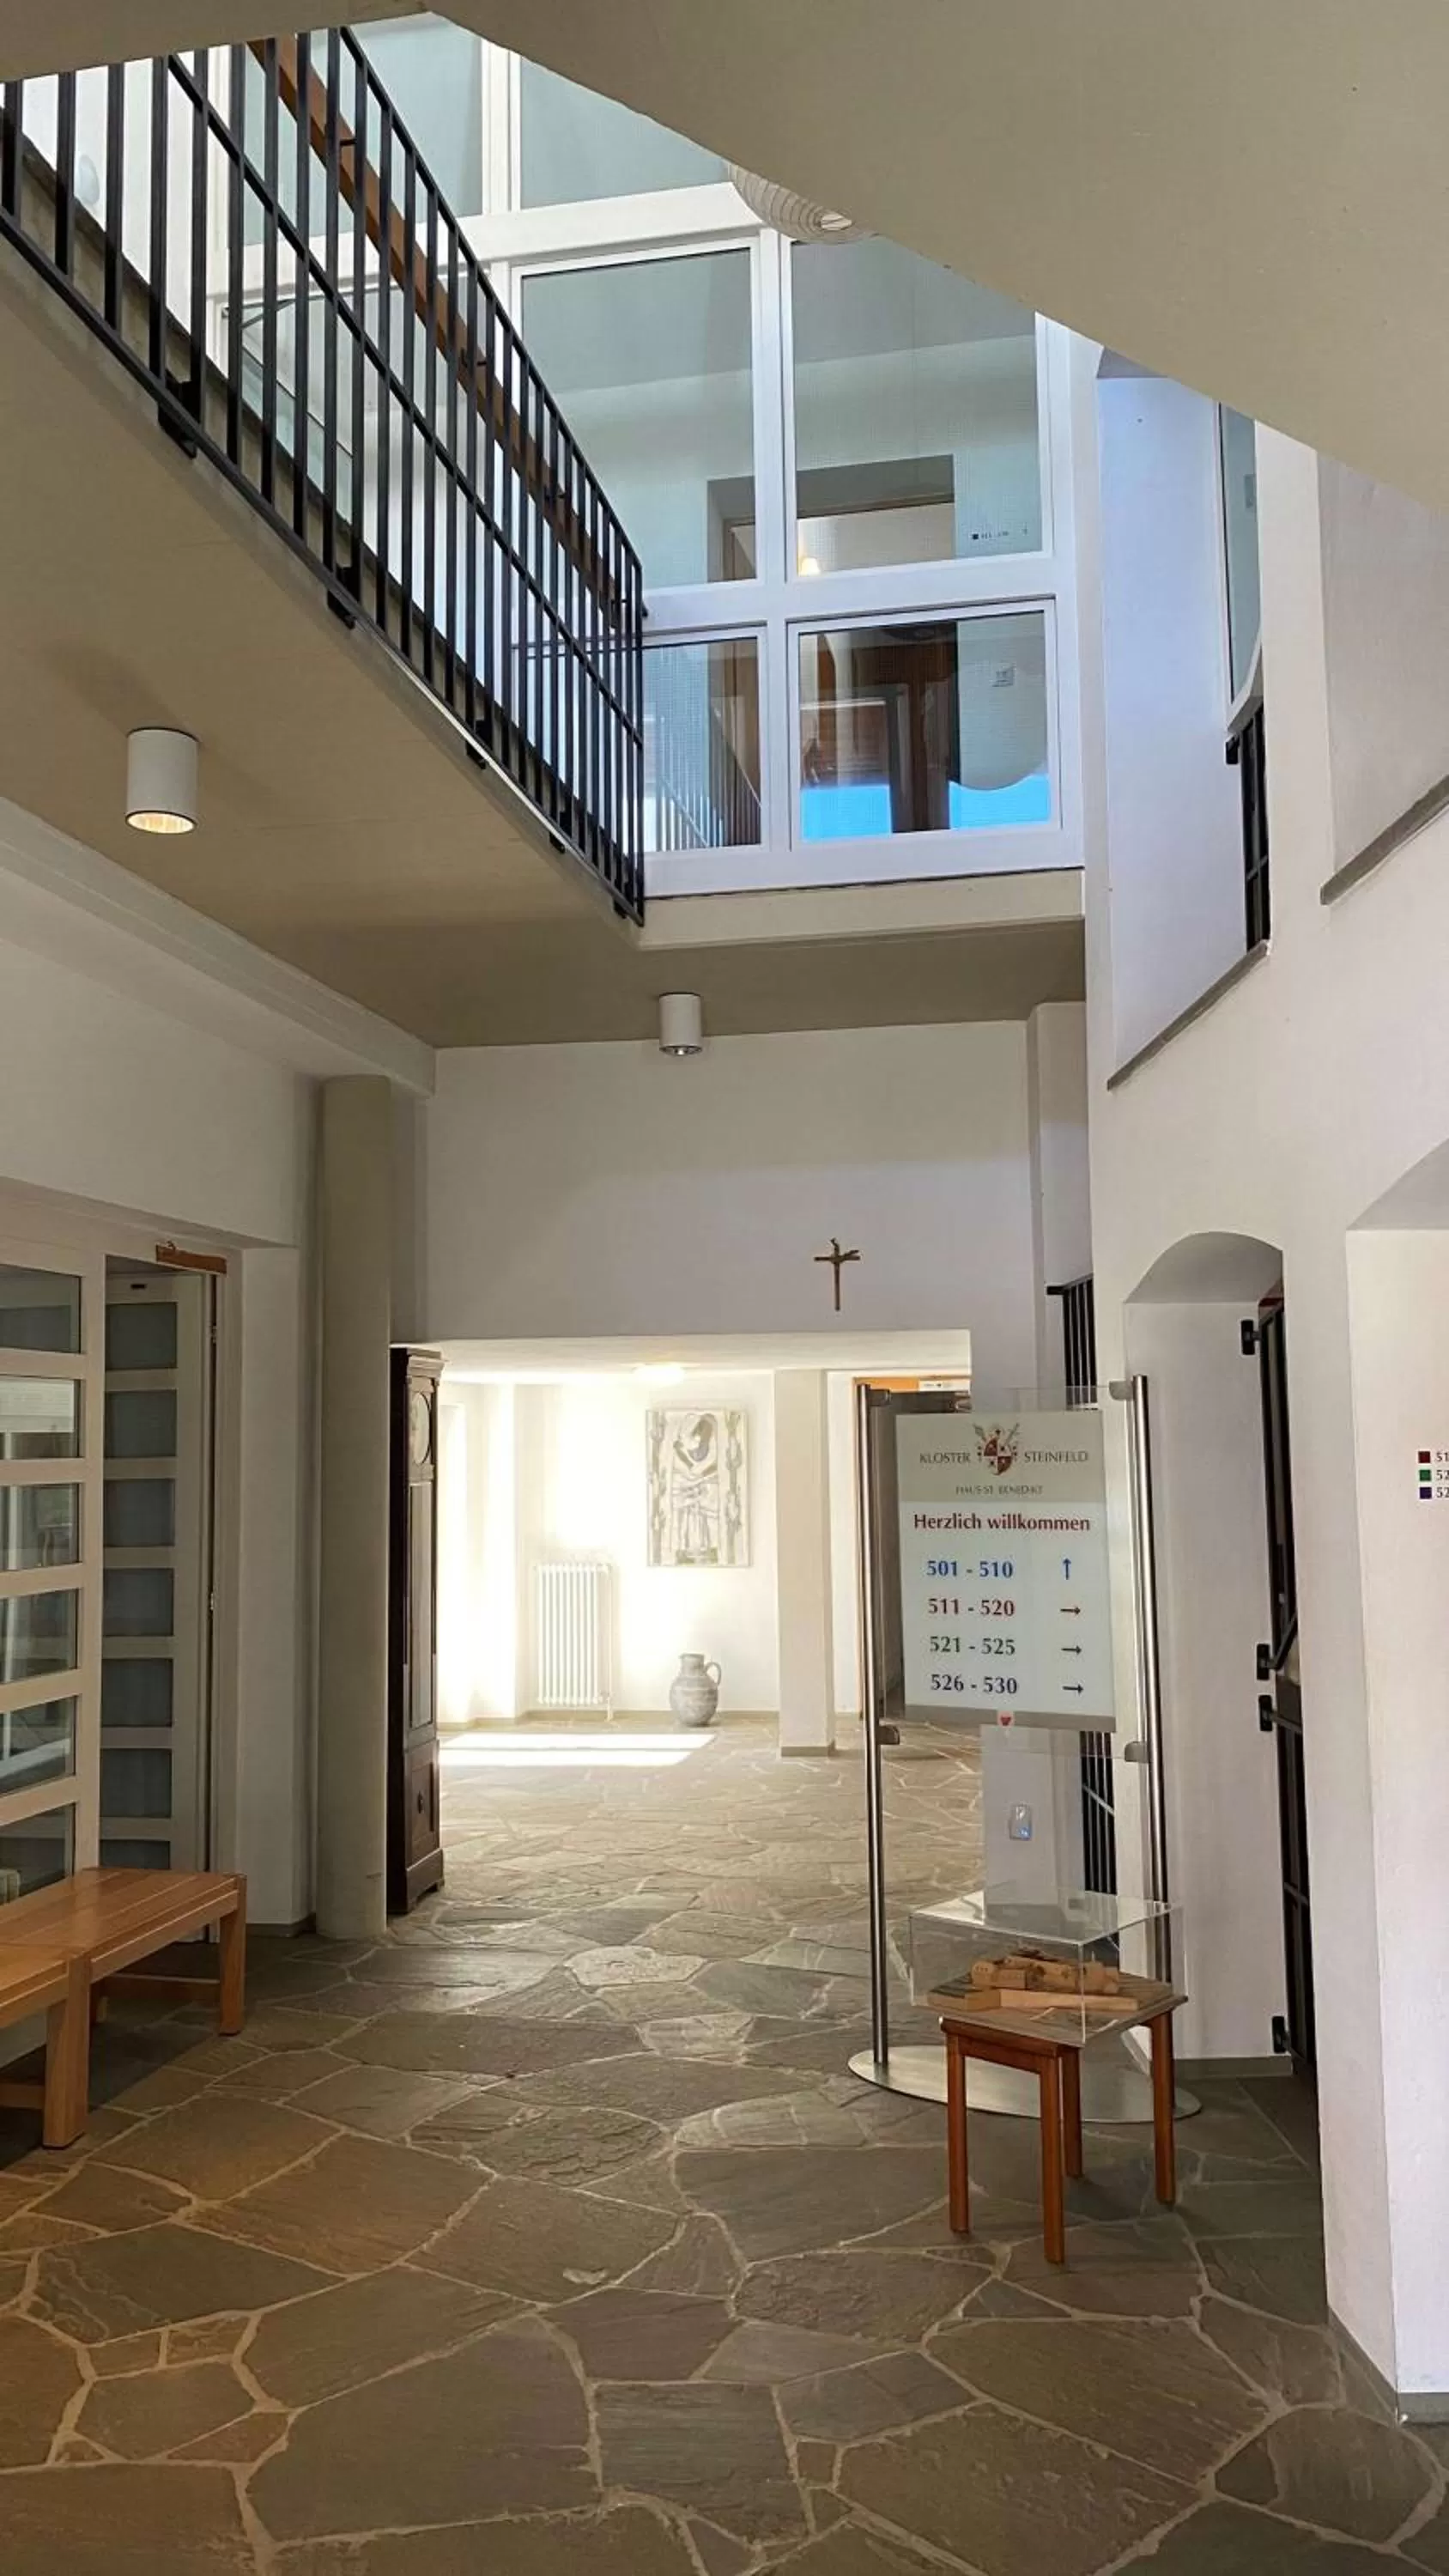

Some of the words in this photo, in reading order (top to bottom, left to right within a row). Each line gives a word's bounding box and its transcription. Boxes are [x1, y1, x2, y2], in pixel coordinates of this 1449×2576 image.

[919, 1452, 971, 1464] KLOSTER
[1024, 1450, 1088, 1463] STEINFELD
[914, 1513, 981, 1529] Herzlich
[986, 1514, 1090, 1532] willkommen
[926, 1560, 959, 1577] 501
[979, 1561, 1014, 1578] 510
[928, 1598, 960, 1615] 511
[979, 1600, 1015, 1617] 520
[930, 1636, 961, 1653] 521
[980, 1638, 1016, 1656] 525
[931, 1674, 964, 1691] 526
[982, 1677, 1018, 1694] 530
